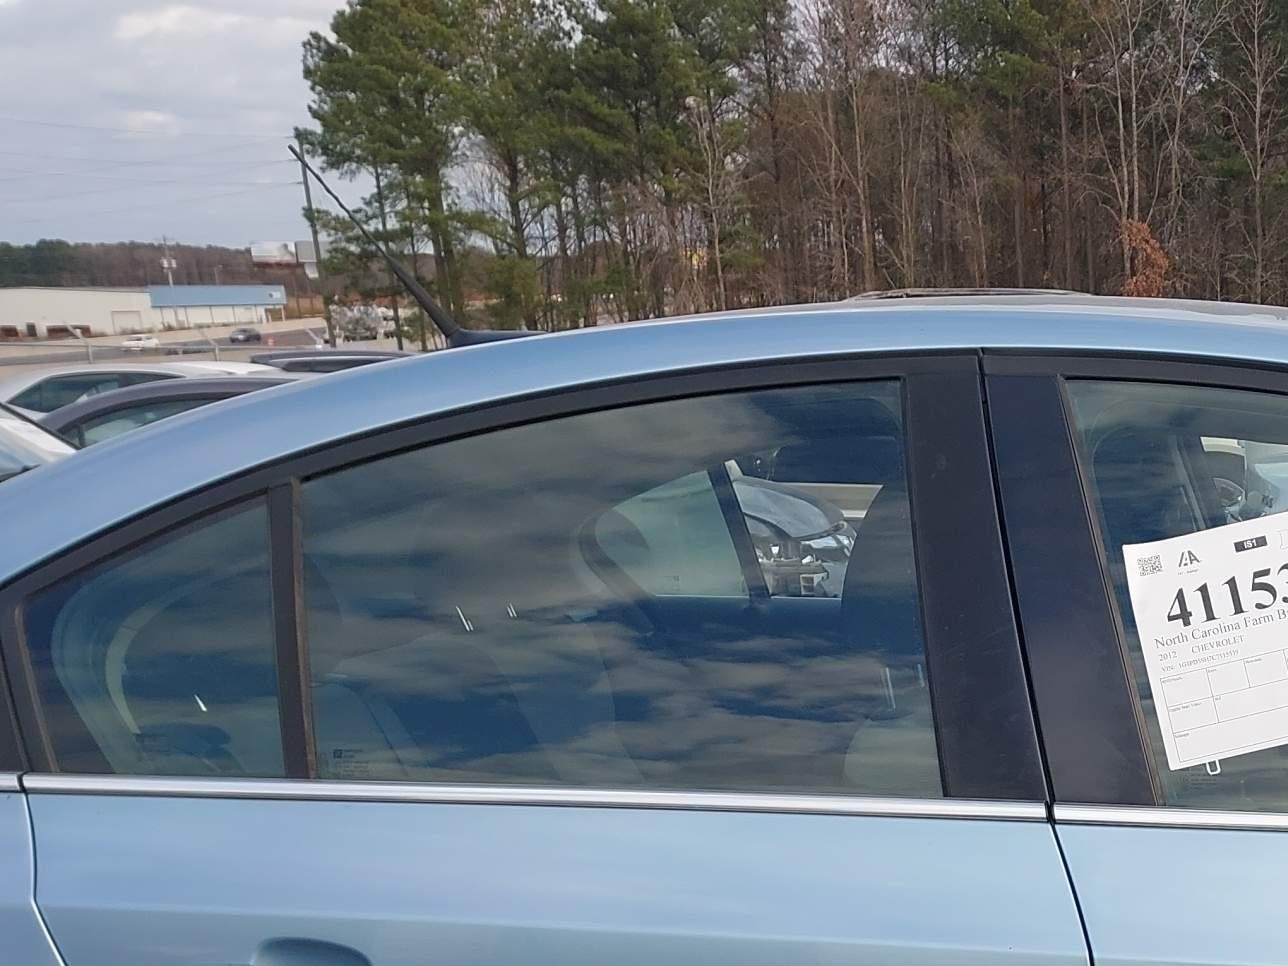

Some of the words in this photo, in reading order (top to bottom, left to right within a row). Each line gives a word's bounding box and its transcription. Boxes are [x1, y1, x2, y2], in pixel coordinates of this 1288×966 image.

[1154, 631, 1189, 649] North
[1191, 620, 1242, 640] Carolina
[1243, 611, 1276, 629] Farm
[1158, 650, 1178, 662] 2012
[1191, 633, 1247, 654] CHEVROLET
